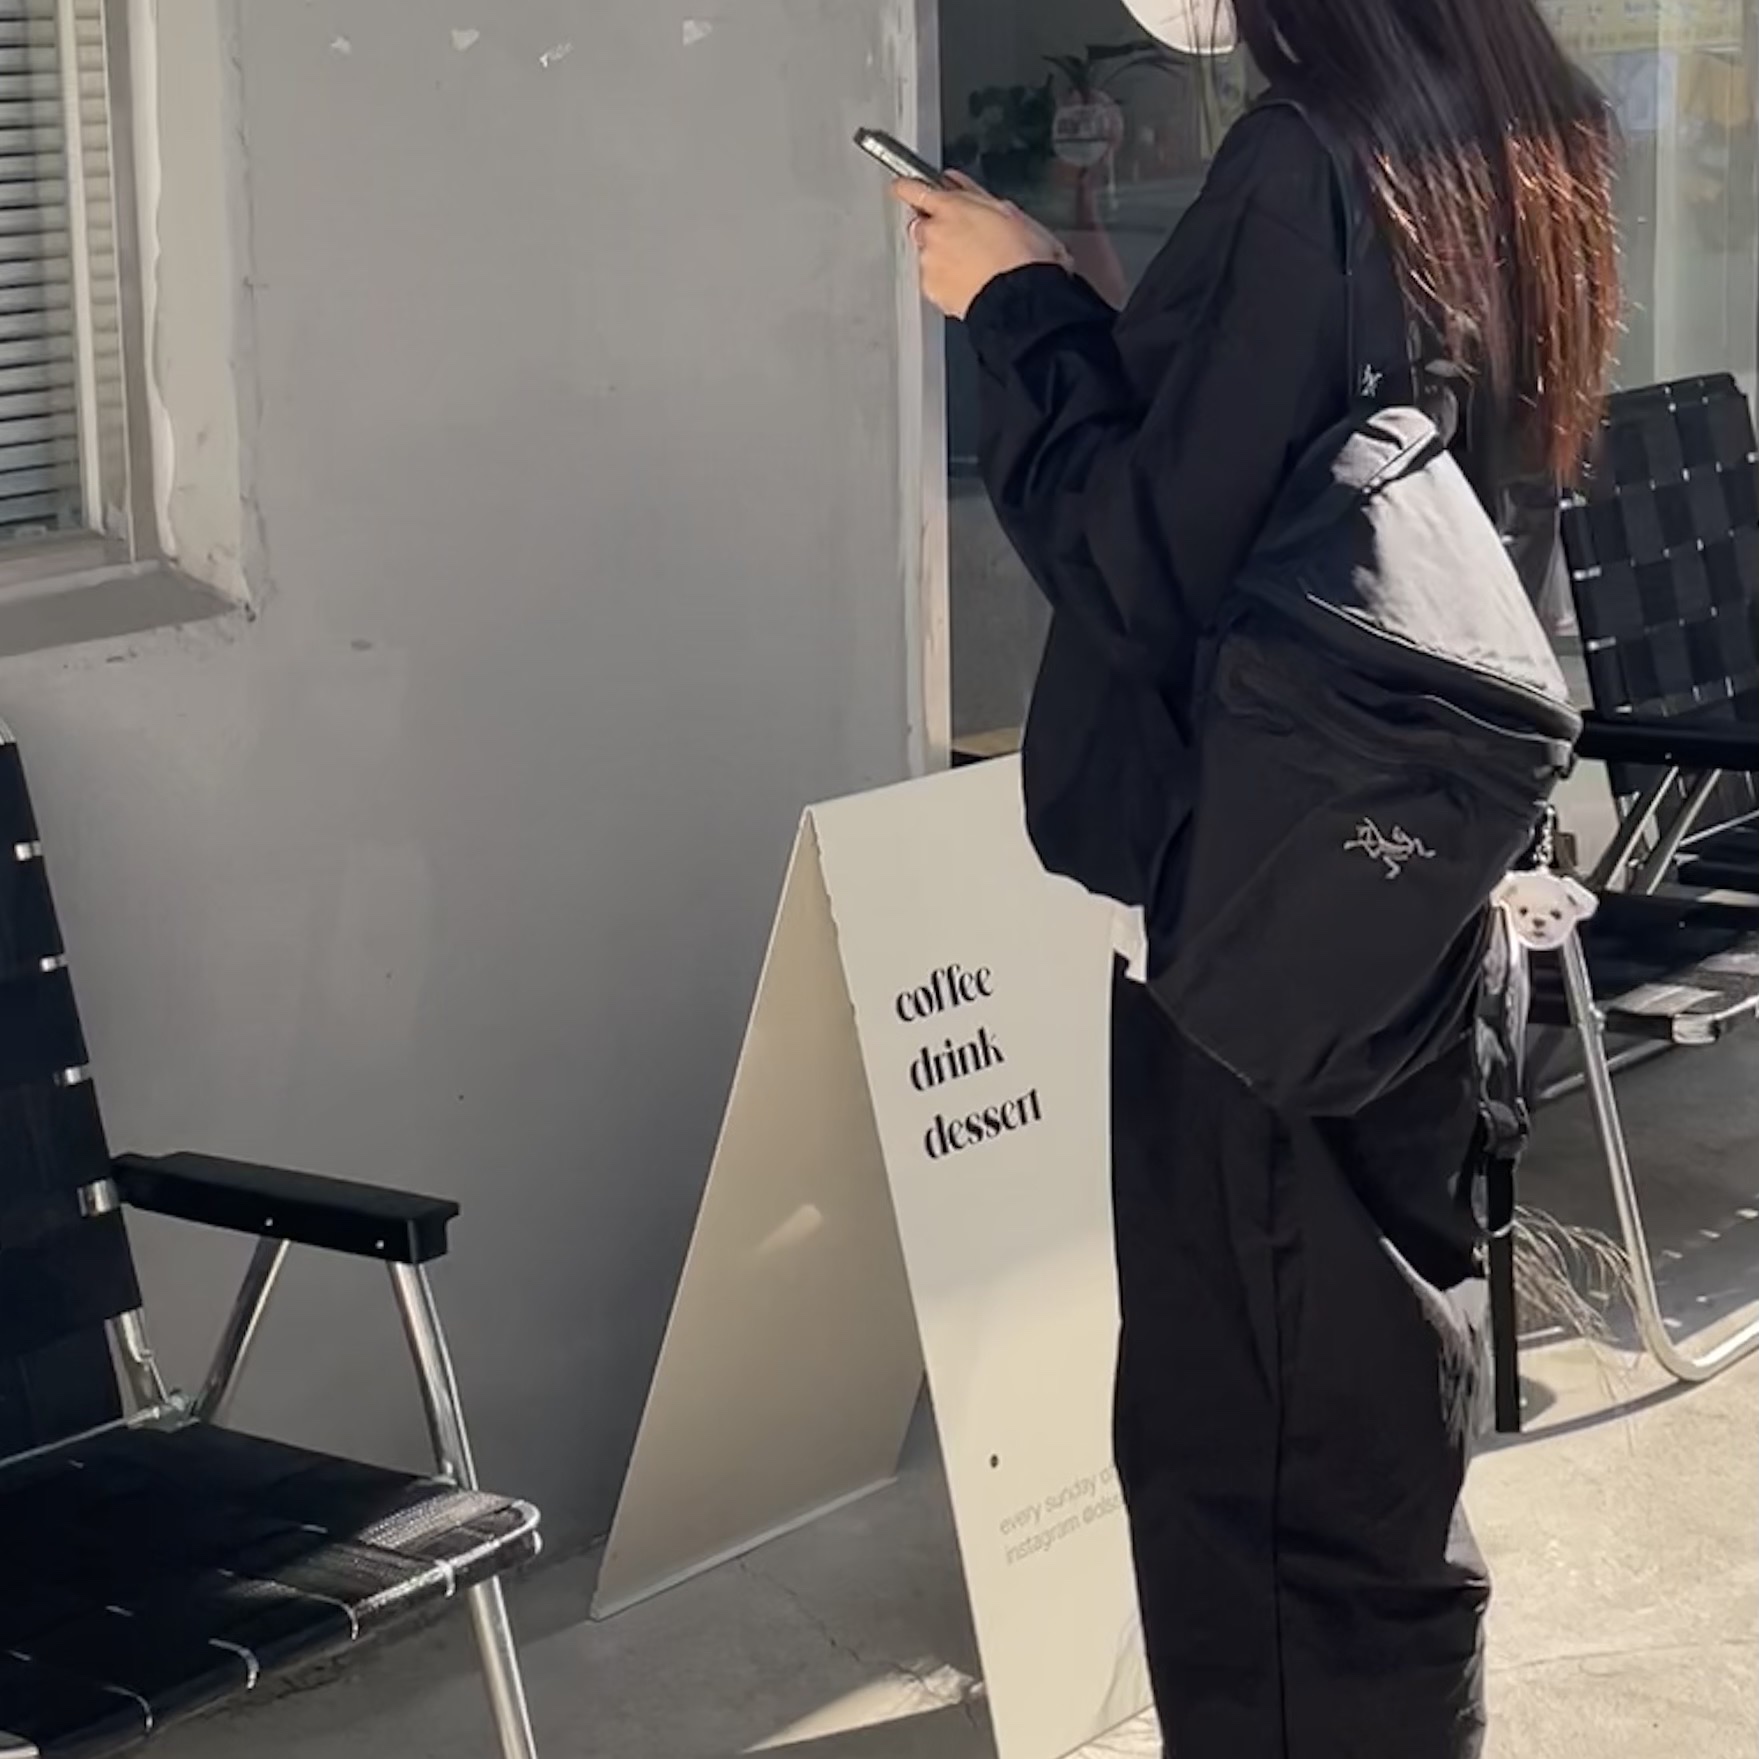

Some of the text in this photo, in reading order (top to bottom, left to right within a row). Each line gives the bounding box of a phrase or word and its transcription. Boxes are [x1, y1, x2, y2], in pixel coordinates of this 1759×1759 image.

[895, 963, 993, 1022] coffee
[909, 1027, 1004, 1092] drink
[924, 1088, 1042, 1159] dessert
[999, 1502, 1042, 1535] every
[1044, 1475, 1096, 1513] sunday
[1004, 1514, 1081, 1566] instagram
